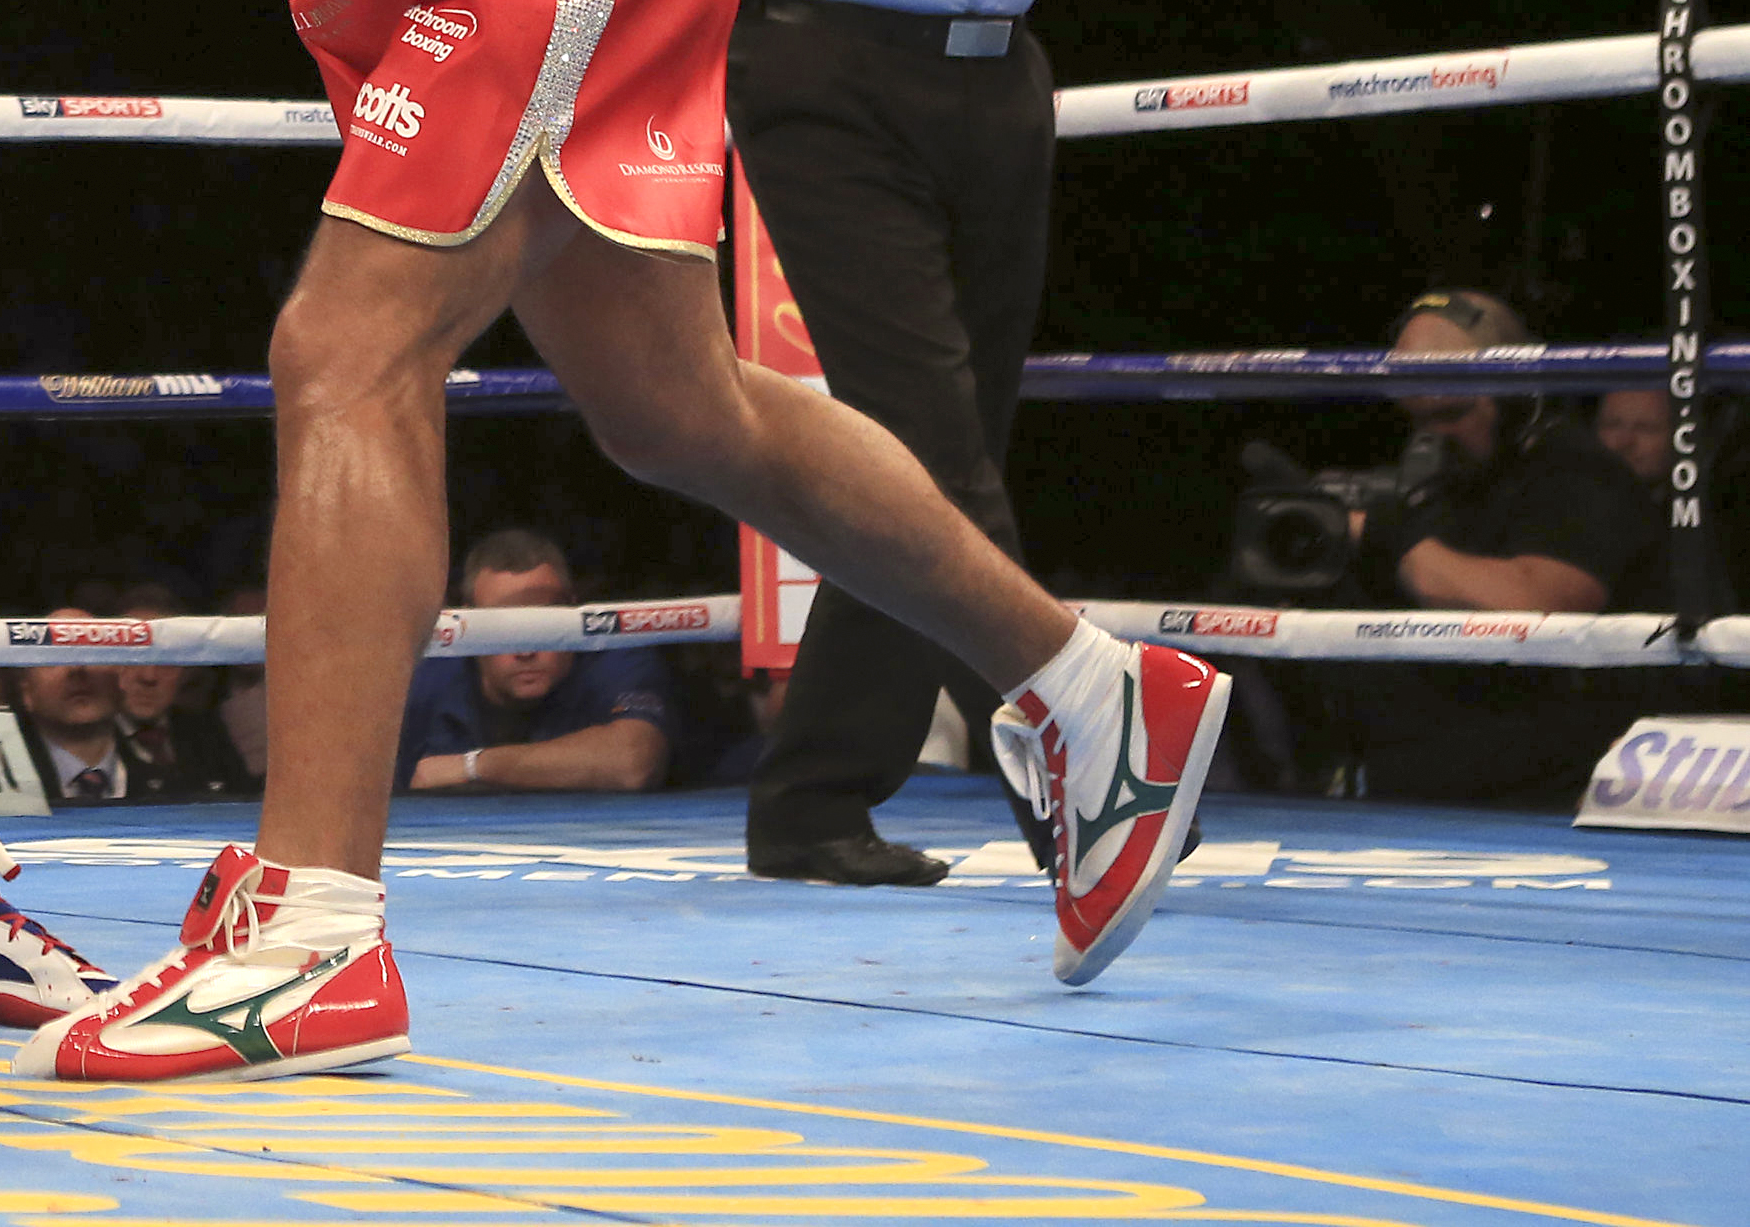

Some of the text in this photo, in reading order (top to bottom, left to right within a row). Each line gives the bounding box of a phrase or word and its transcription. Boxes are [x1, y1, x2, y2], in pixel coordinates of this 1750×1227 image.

[401, 24, 454, 63] boxing
[21, 96, 159, 117] sky SPORTS
[1167, 83, 1248, 108] SPORTS
[151, 374, 222, 396] HILL
[622, 606, 708, 632] SPORTS
[1194, 612, 1275, 636] SPORTS
[9, 622, 148, 645] sky SPORTS
